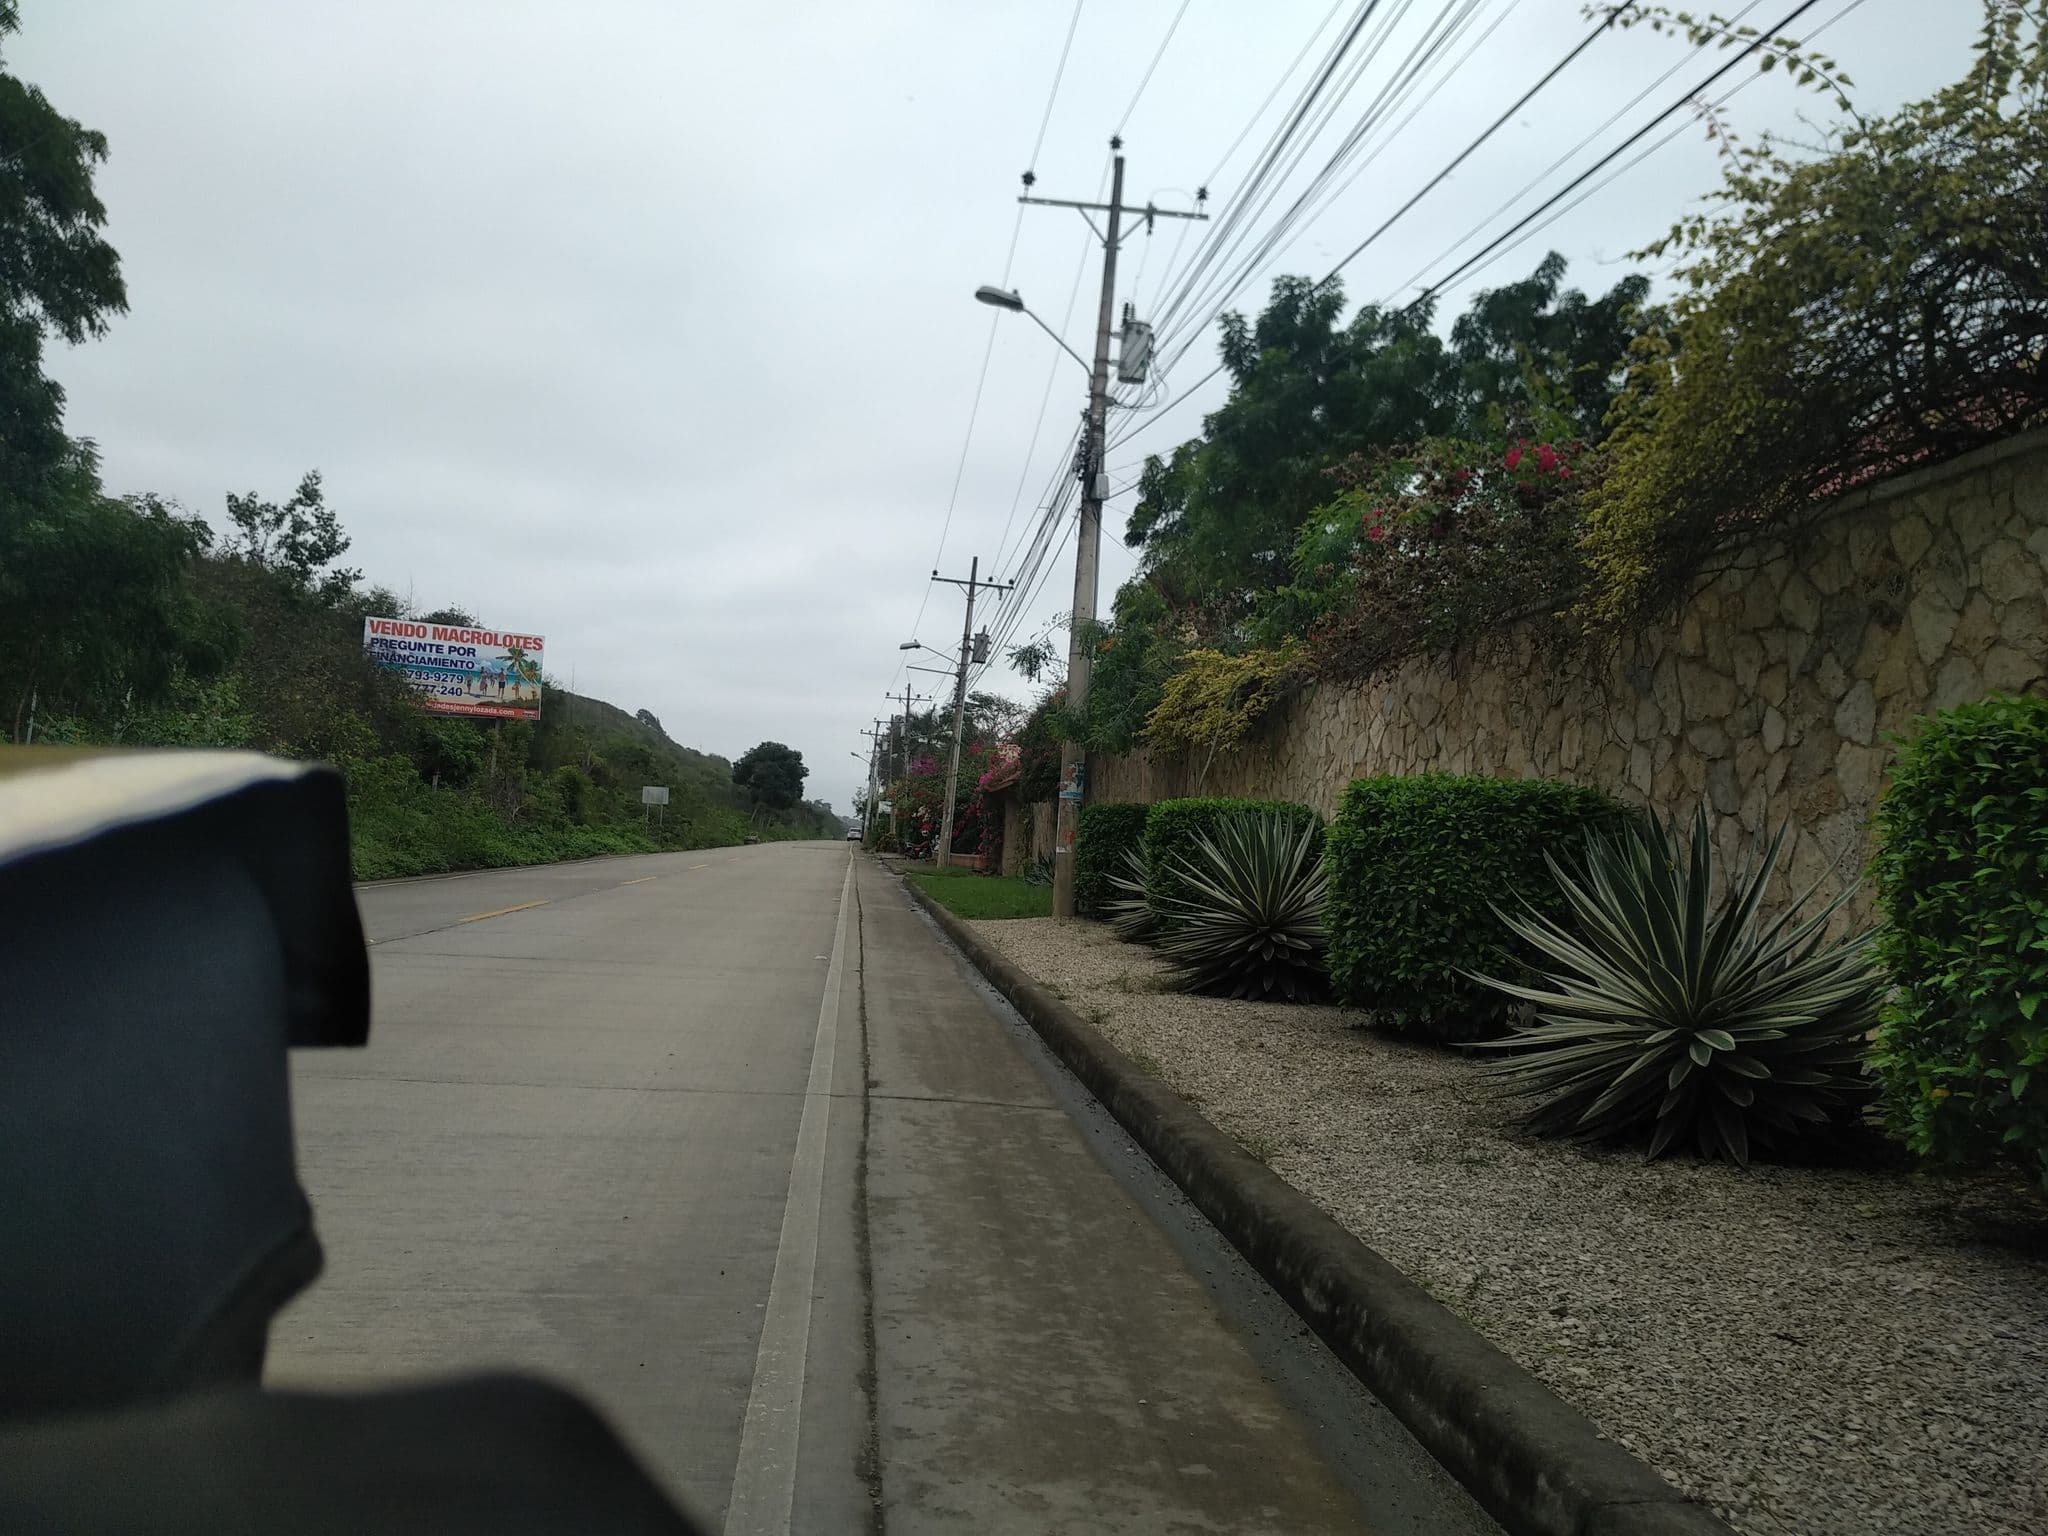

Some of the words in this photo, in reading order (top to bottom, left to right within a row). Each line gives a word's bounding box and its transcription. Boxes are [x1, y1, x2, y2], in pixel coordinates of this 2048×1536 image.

[369, 620, 427, 638] VENDO
[432, 626, 543, 651] MACROLOTES
[371, 637, 445, 654] PREGUNTE
[448, 645, 476, 657] POR
